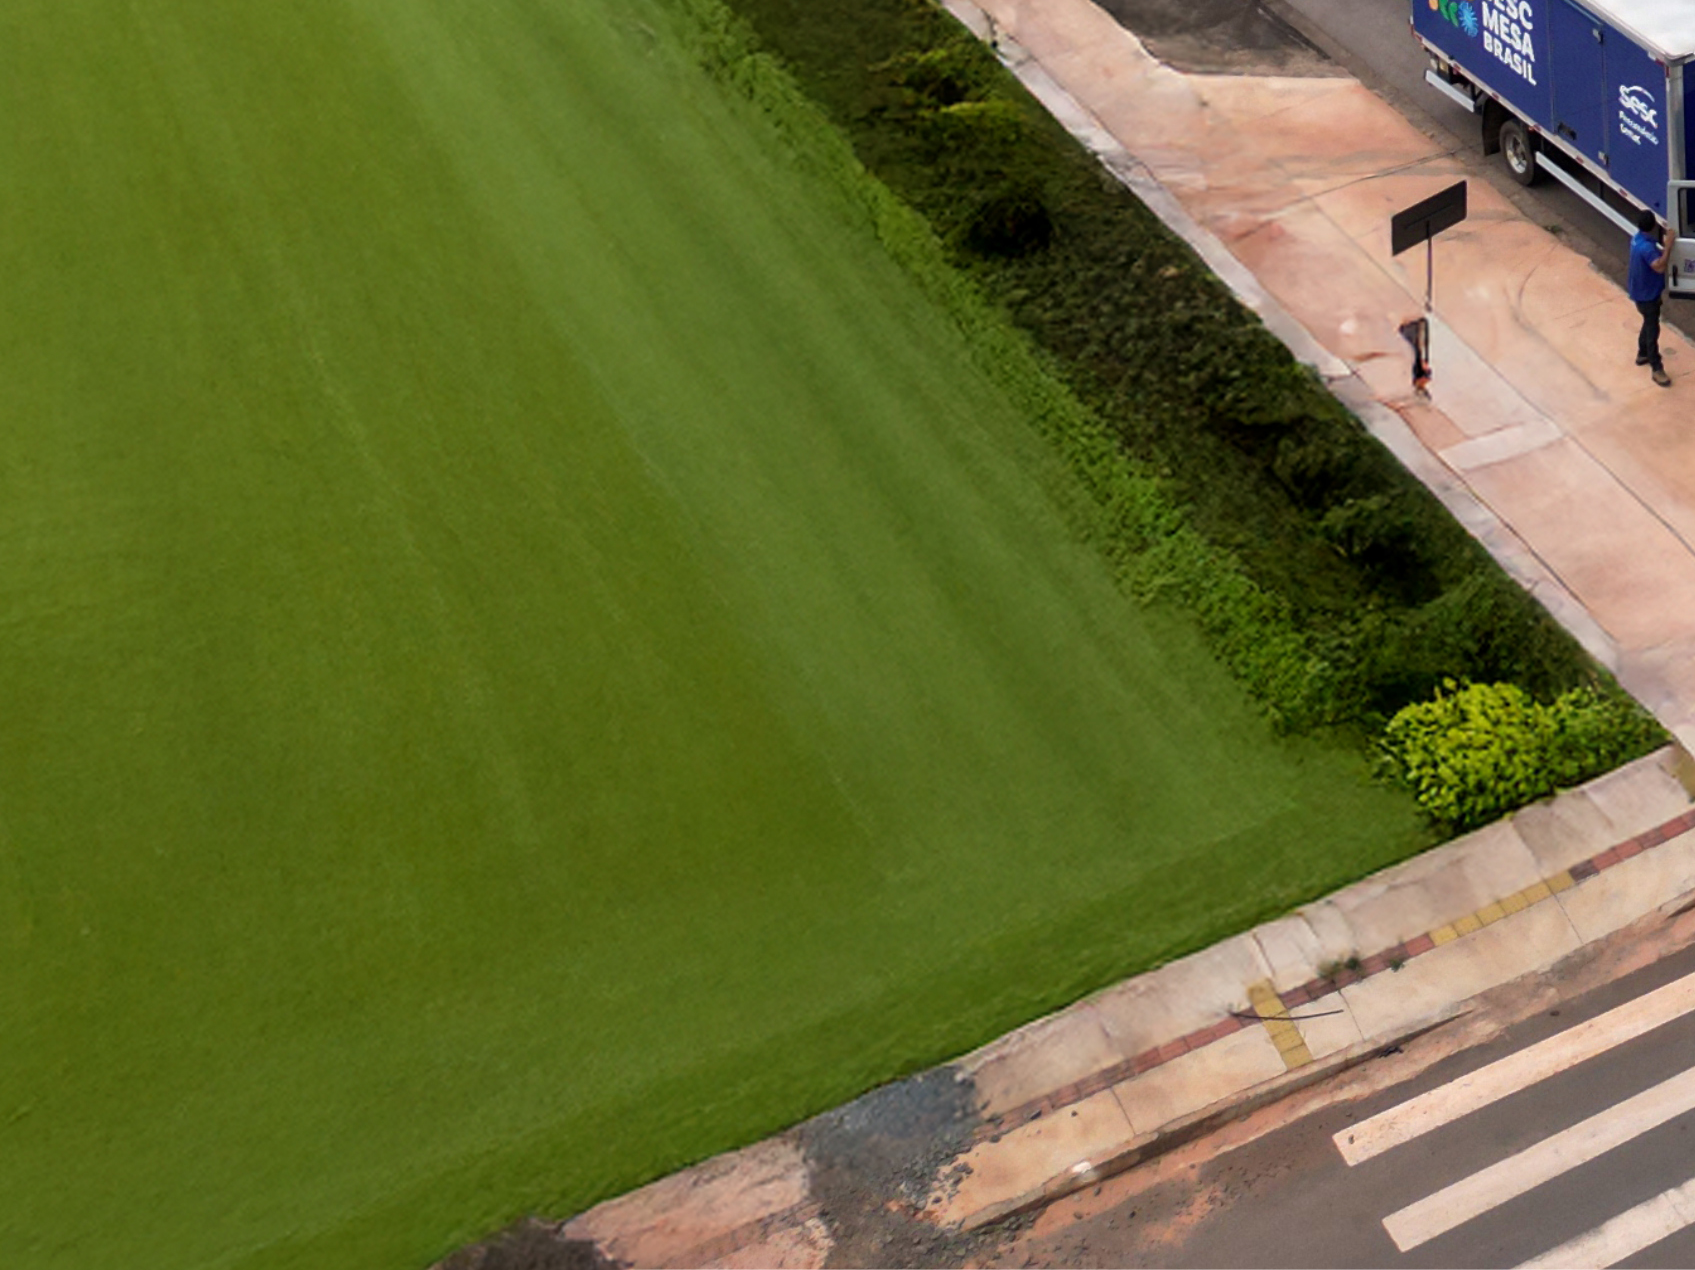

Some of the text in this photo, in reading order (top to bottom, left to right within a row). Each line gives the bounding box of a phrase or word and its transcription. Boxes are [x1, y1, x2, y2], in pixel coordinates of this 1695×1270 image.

[1482, 1, 1535, 63] MESA
[1483, 30, 1537, 87] BRASIL
[1619, 84, 1658, 129] Sesc
